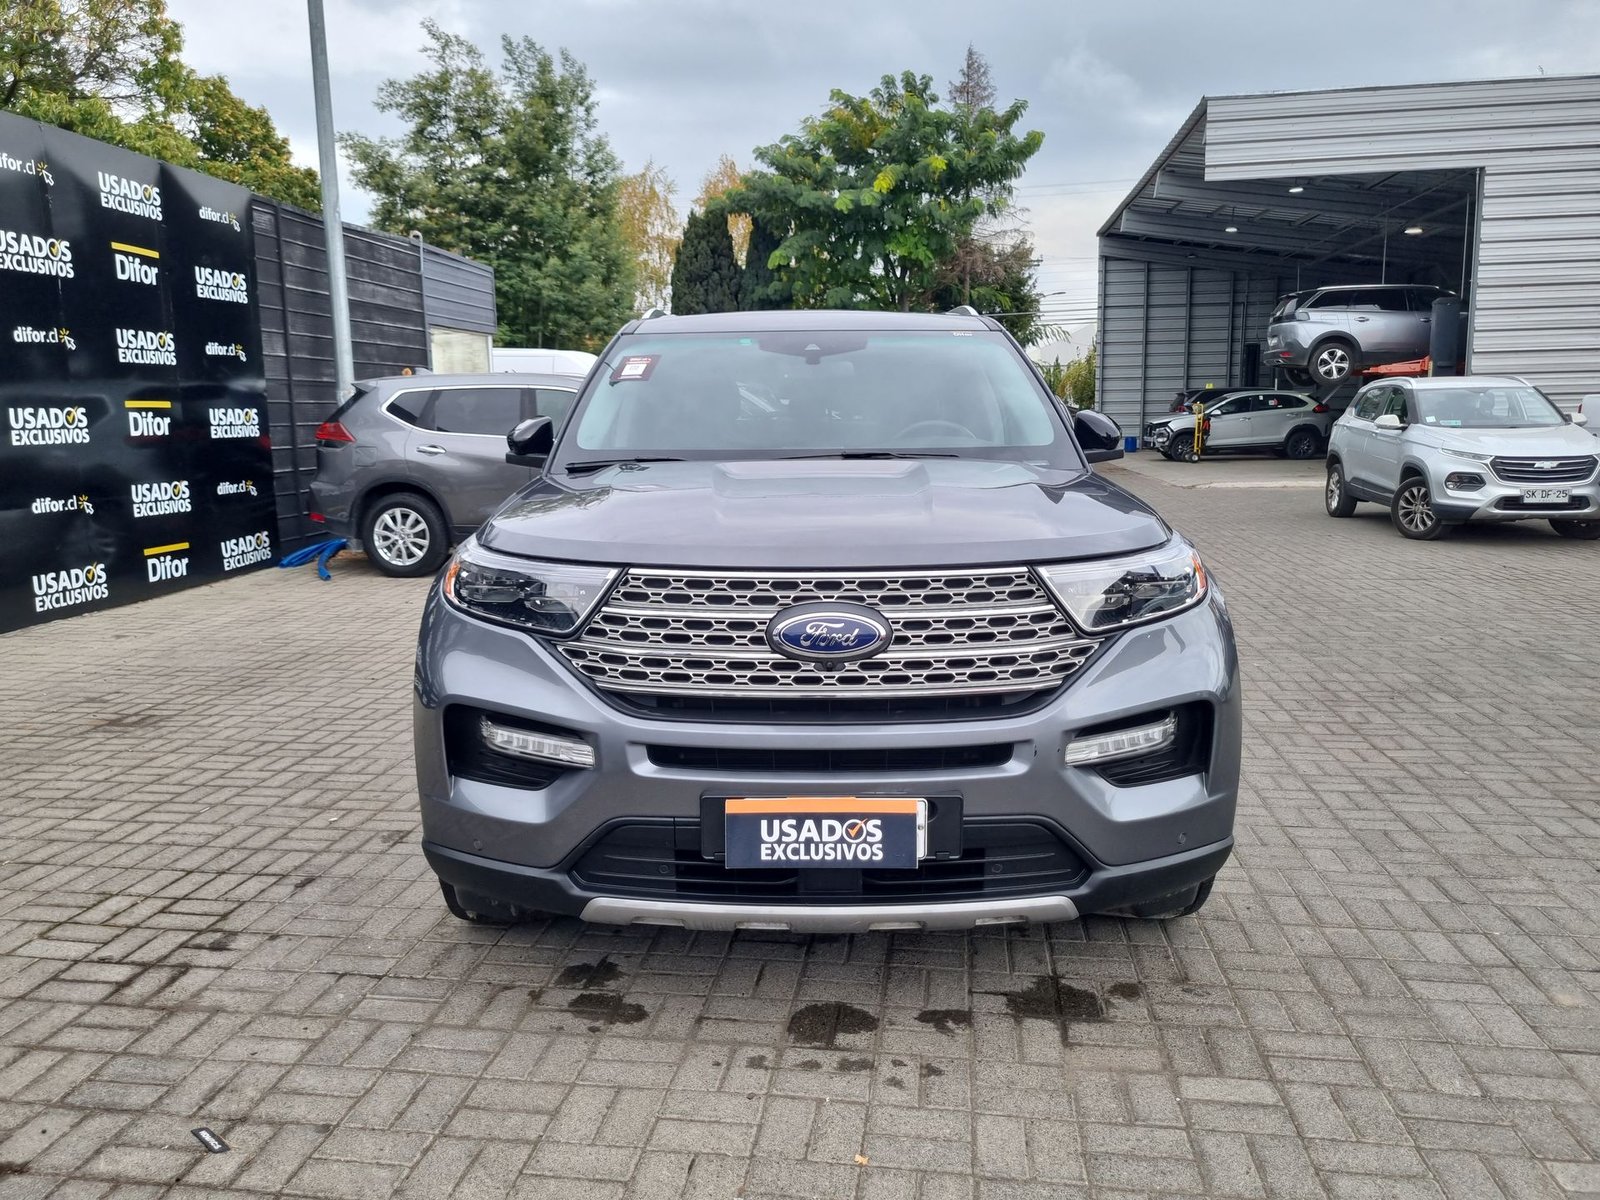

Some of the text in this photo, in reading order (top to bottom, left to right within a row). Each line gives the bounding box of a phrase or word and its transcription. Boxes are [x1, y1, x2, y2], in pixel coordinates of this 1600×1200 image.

[98, 171, 161, 205] USADOS
[101, 194, 162, 221] EXCLUSIVOS
[199, 206, 229, 224] difor.cl
[115, 253, 159, 285] Difor
[195, 266, 247, 291] USADOS
[197, 285, 248, 304] EXCLUSIVOS
[13, 326, 58, 343] difor.cl
[116, 328, 175, 350] USADOS
[118, 349, 176, 366] EXCLUSIVOS
[205, 342, 235, 356] difor.cl
[9, 407, 87, 429] USADOS
[129, 411, 171, 437] Difor
[209, 408, 259, 426] USADOS
[11, 428, 90, 446] EXCLUSIVOS
[211, 424, 260, 439] EXCLUSIVOS
[131, 481, 190, 503] USADOS
[217, 480, 246, 495] difor.cl
[32, 495, 77, 514] difor.cl
[133, 499, 191, 517] EXCLUSIVOS
[221, 531, 270, 558] USADOS
[147, 556, 189, 582] Difor
[224, 547, 272, 571] EXCLUSIVOS
[32, 563, 107, 595] USADOS
[35, 583, 109, 613] EXCLUSIVOS
[800, 621, 860, 647] Ford
[760, 818, 883, 843] USADOS
[760, 843, 884, 861] EXCLUSIVOS
